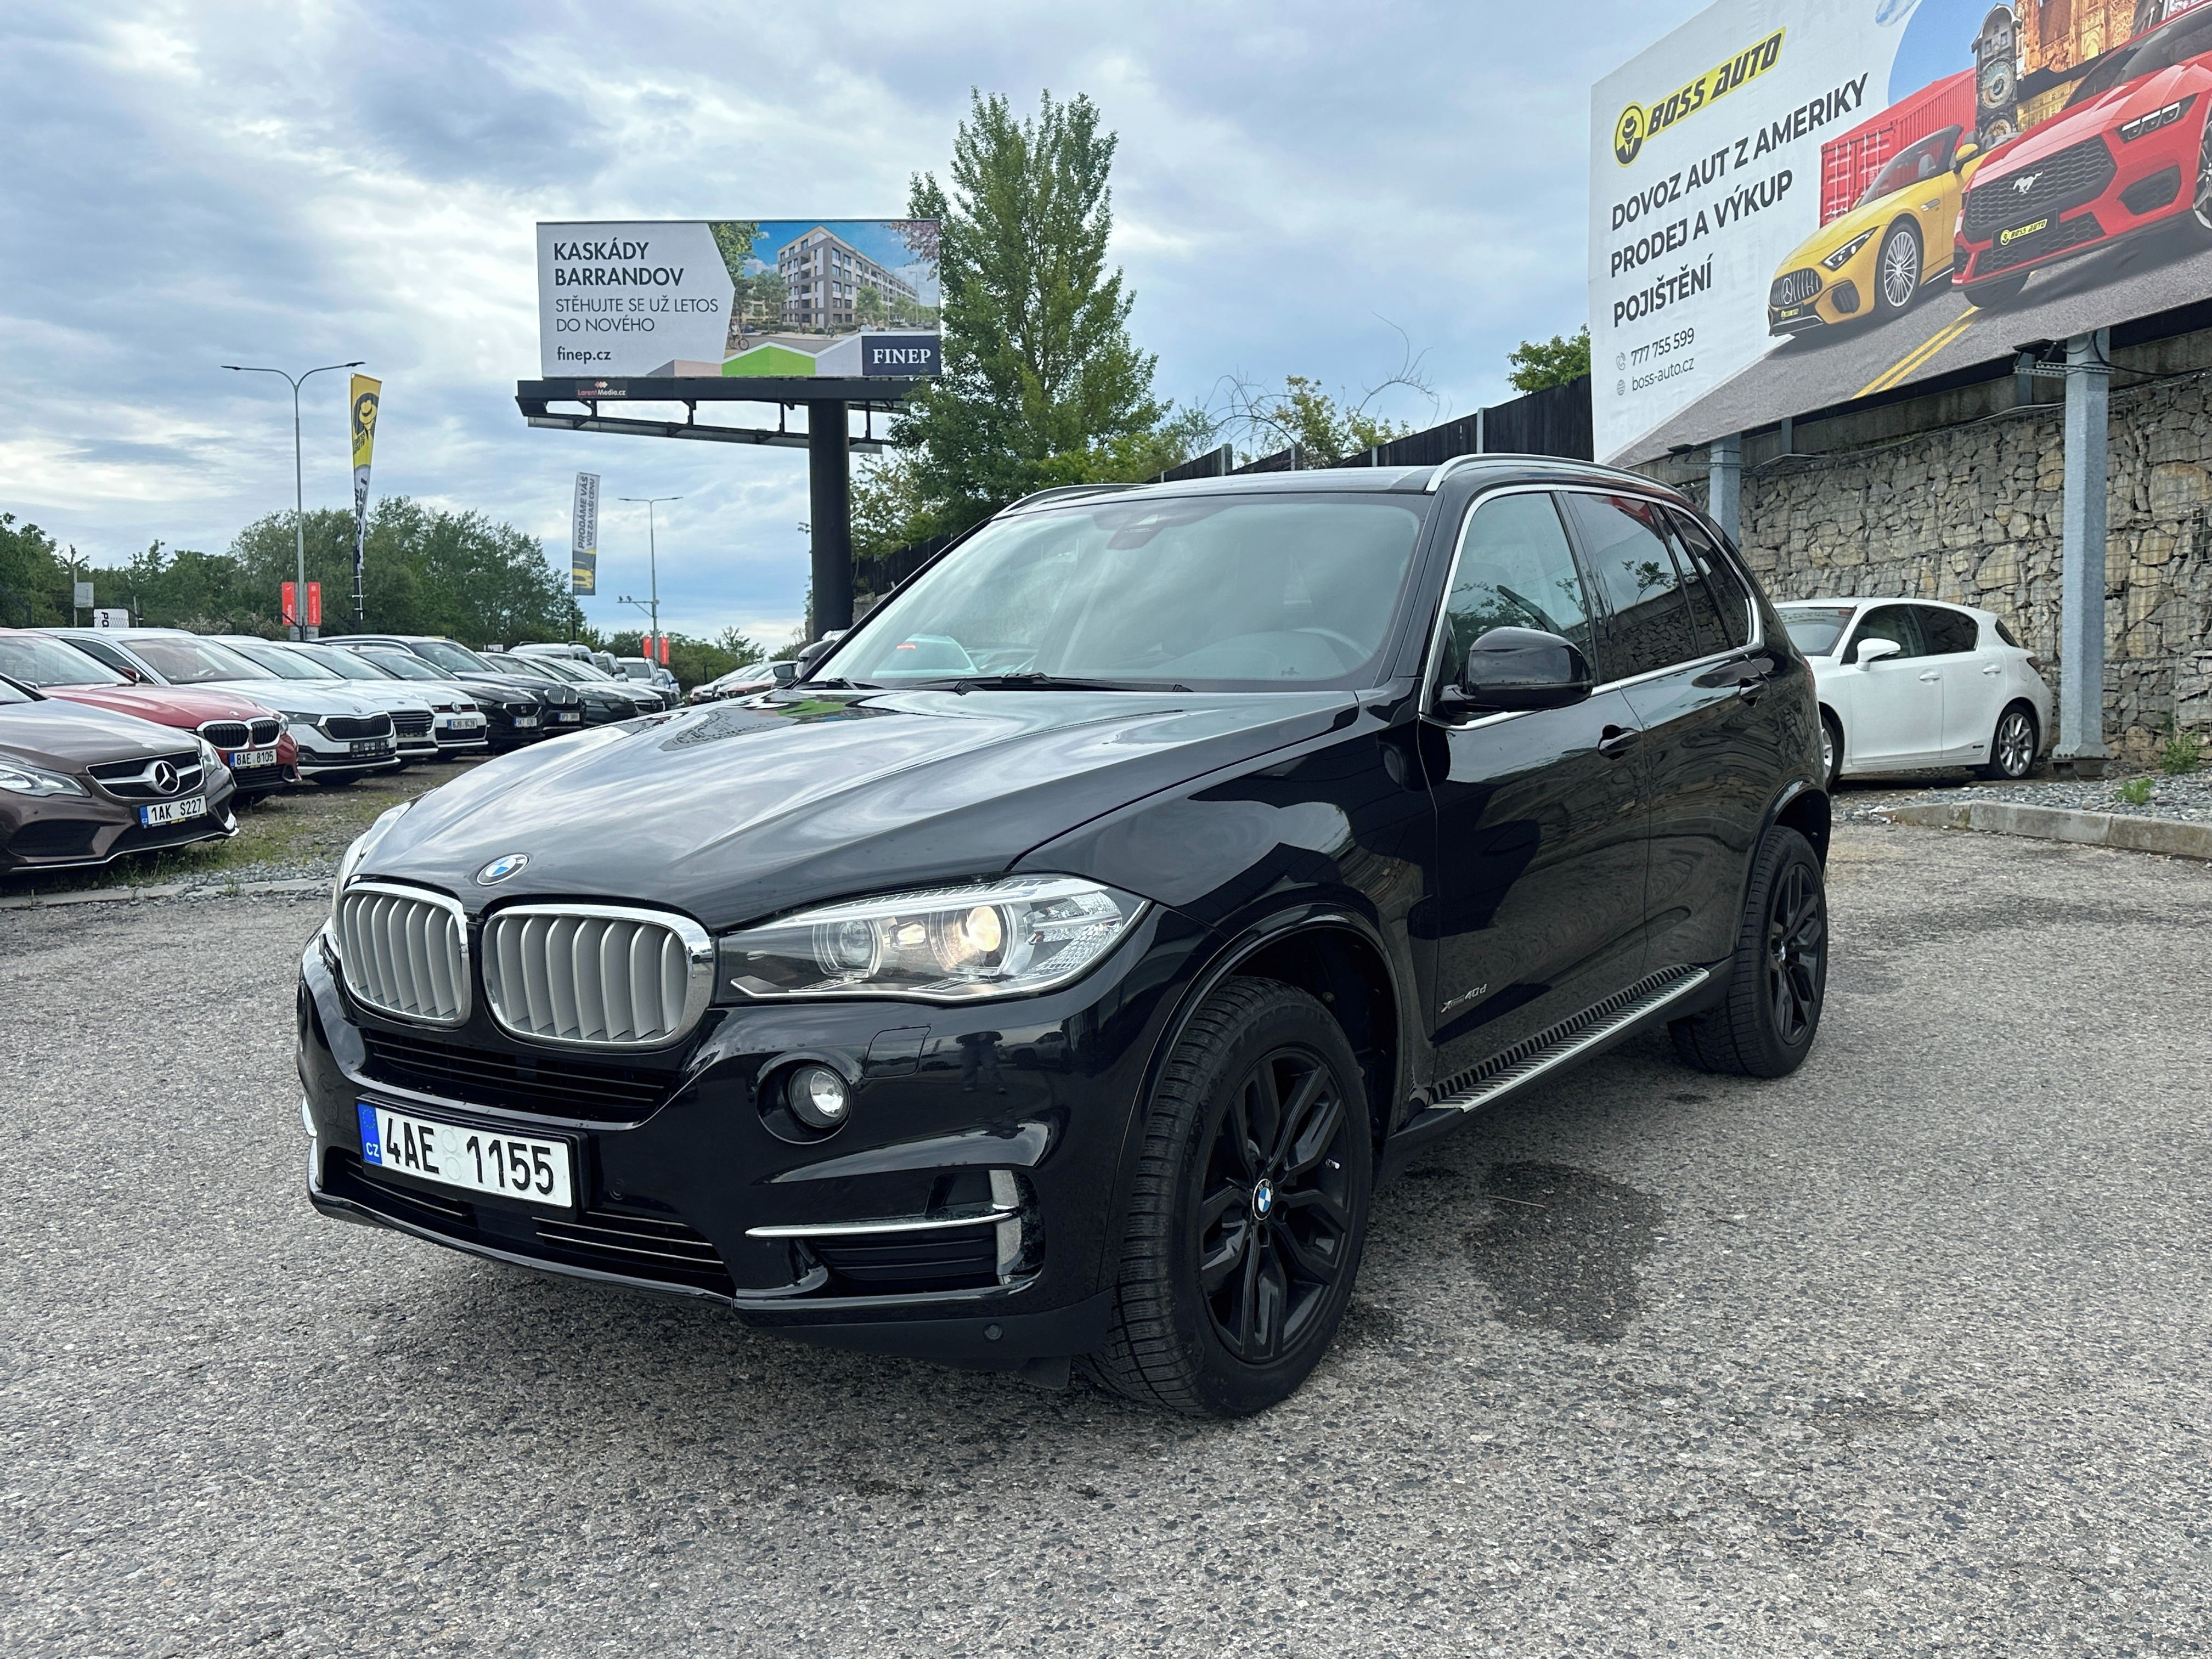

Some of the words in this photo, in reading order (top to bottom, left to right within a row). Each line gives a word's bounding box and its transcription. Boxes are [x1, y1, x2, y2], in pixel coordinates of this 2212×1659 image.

[1647, 84, 1706, 137] BOSS
[1710, 32, 1782, 100] AUTO
[1612, 172, 1682, 231] DOVOZ
[1685, 146, 1730, 194] AUT
[1734, 137, 1748, 170] Z
[1753, 72, 1868, 160] AMERIKY
[1611, 218, 1688, 278] PRODEJ
[1693, 210, 1709, 240] A
[1714, 170, 1793, 228] VÝKUP
[554, 236, 650, 261] KASKÁDY
[555, 267, 685, 286] BARRANDOV
[1614, 253, 1714, 328] POJIŠTĚNÍ
[556, 295, 624, 312] STĚHUJTE
[629, 298, 645, 312] SE
[650, 295, 670, 312] UŽ
[674, 298, 718, 313] LETOS
[556, 318, 580, 332] DO
[585, 314, 655, 332] NOVÉHO
[557, 346, 612, 364] finep.cz
[872, 348, 932, 364] FINEP
[1631, 345, 1650, 366] 777
[1652, 336, 1671, 358] 755
[1673, 328, 1694, 349] 599
[1632, 358, 1694, 391] boss-auto.cz
[579, 476, 588, 496] VÁŠ
[577, 498, 587, 549] PRODÁME
[588, 520, 593, 531] ZA
[236, 753, 251, 765] 8AE
[257, 751, 273, 763] 8105
[151, 804, 172, 821] 1AK
[180, 798, 201, 816] S227
[366, 1141, 380, 1158] CZ
[386, 1118, 439, 1175] 4AE
[466, 1136, 554, 1195] 1155
